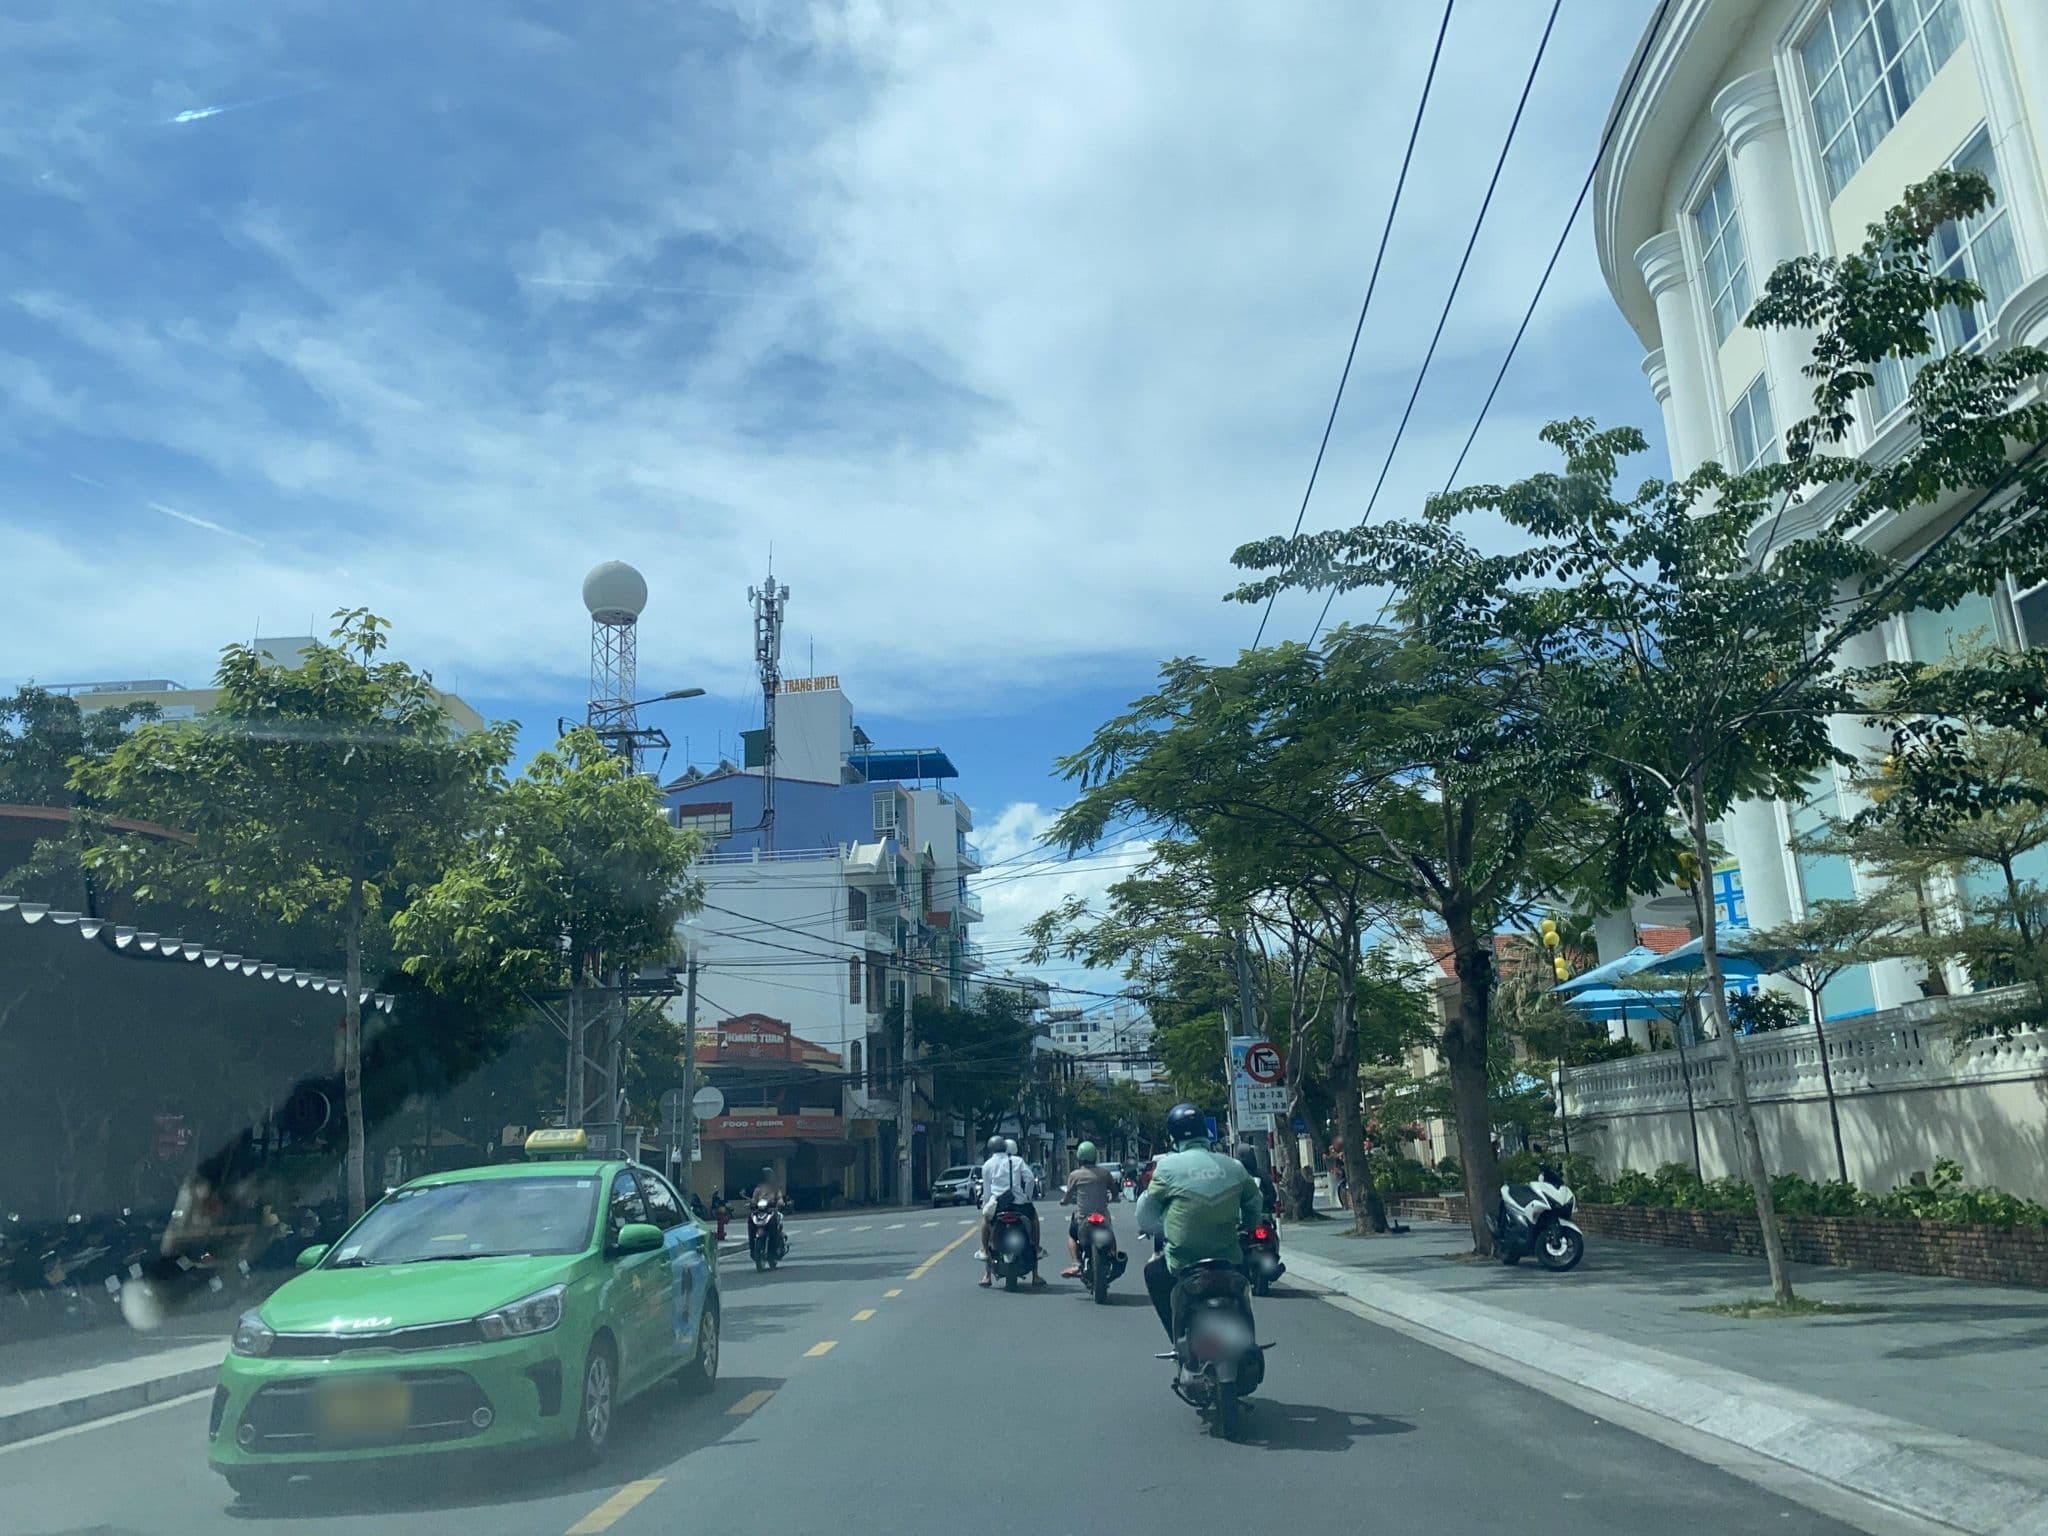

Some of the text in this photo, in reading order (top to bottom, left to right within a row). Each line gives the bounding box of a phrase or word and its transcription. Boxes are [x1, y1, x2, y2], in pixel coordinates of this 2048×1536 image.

[784, 678, 813, 693] TRANG
[814, 675, 839, 691] HOTEL
[720, 1120, 748, 1128] FOOD
[1187, 1166, 1226, 1180] Grab
